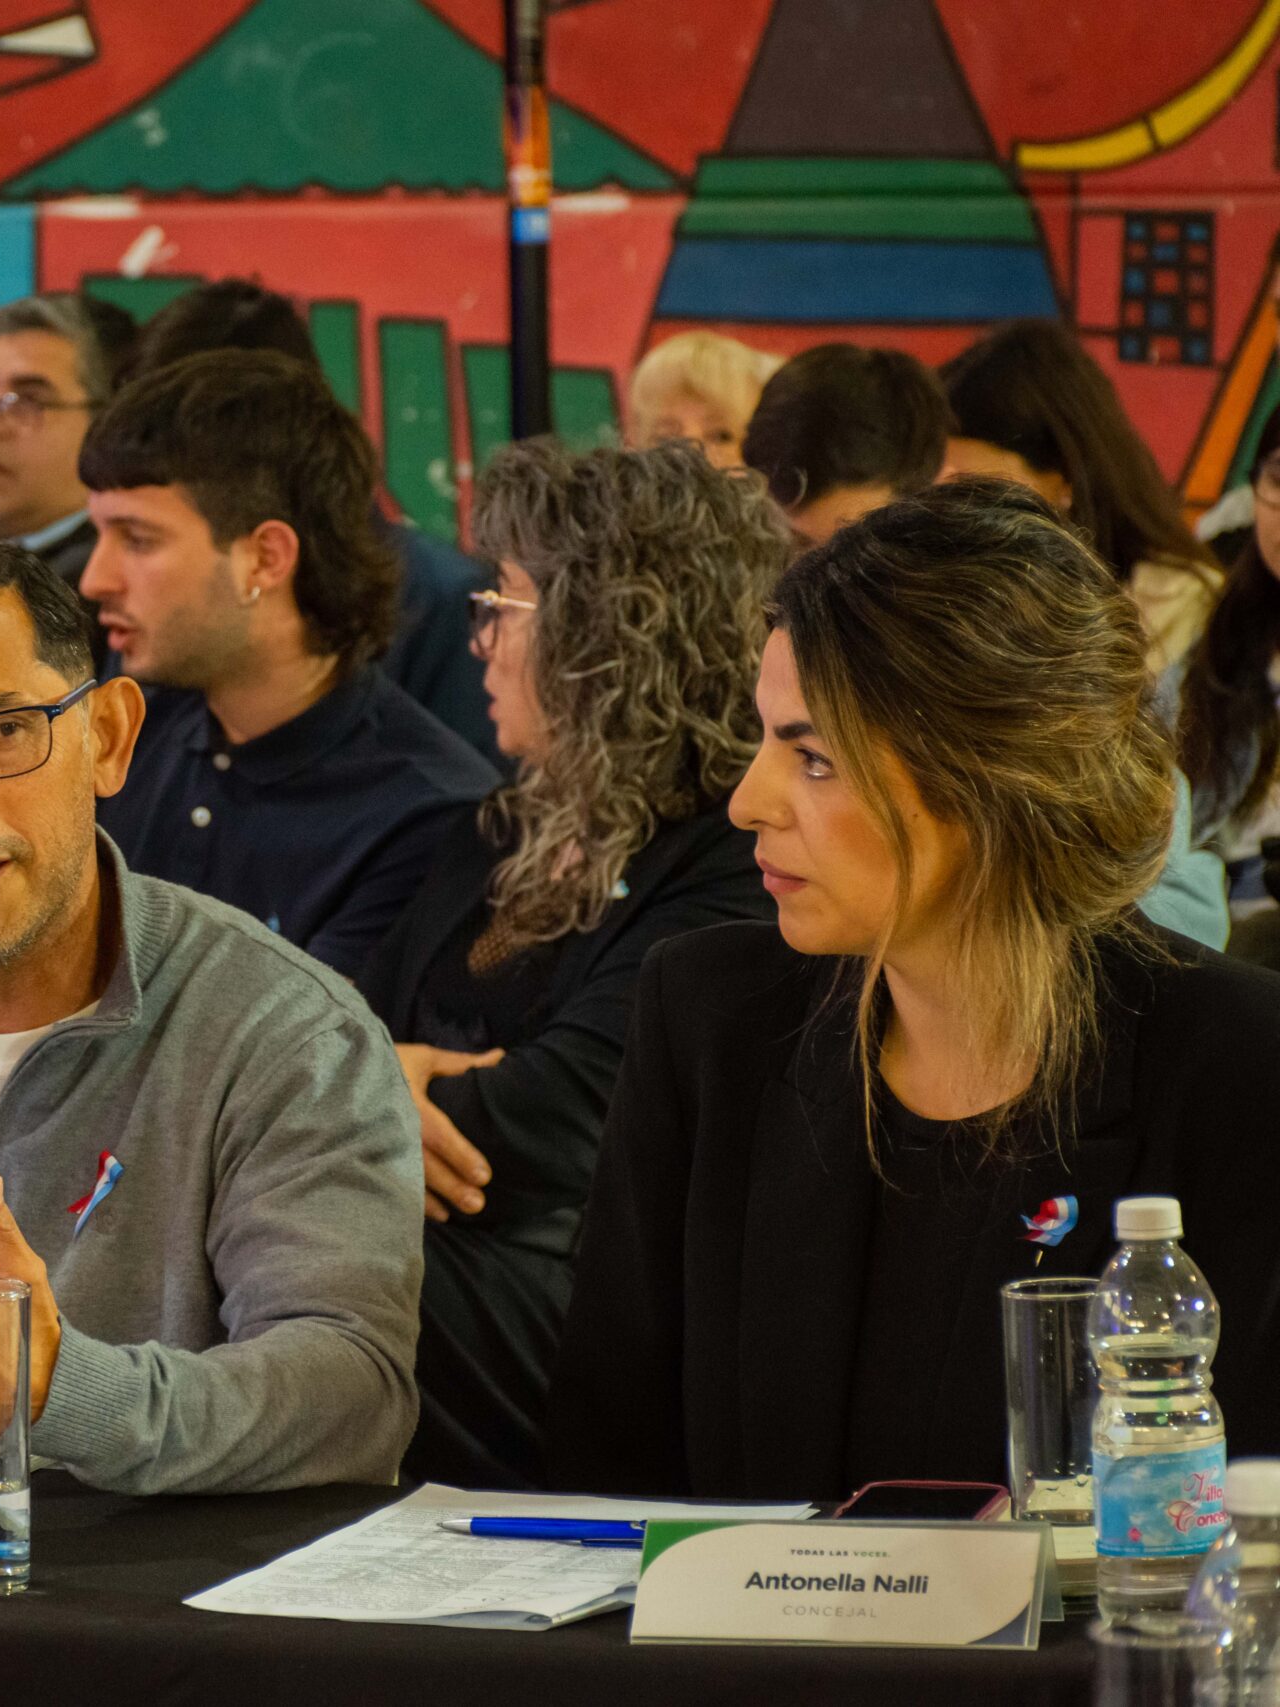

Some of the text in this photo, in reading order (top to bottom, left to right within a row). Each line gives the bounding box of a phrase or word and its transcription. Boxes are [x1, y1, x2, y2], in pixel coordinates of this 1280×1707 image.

[790, 1549, 825, 1557] TODAS
[745, 1571, 929, 1594] Antonella Nalli
[782, 1605, 878, 1618] CONCEJAL
